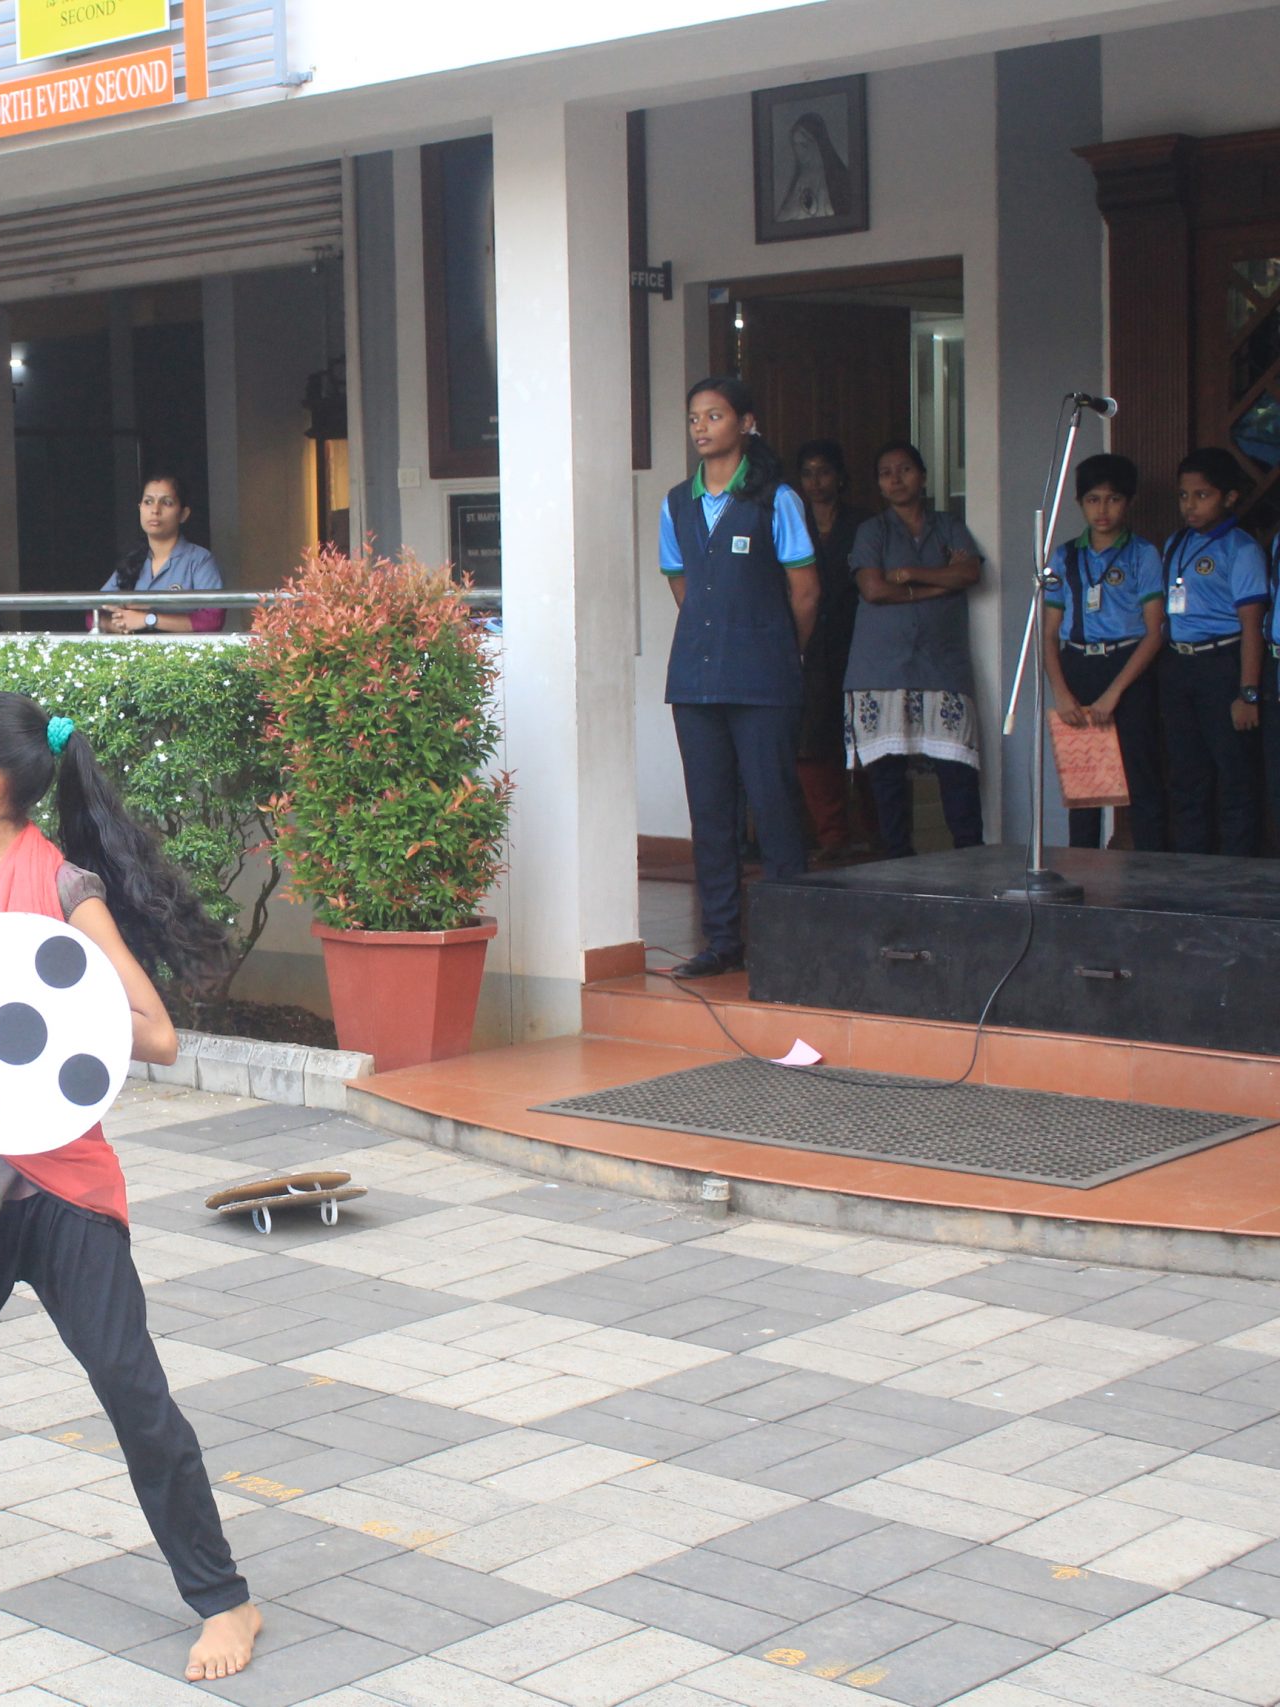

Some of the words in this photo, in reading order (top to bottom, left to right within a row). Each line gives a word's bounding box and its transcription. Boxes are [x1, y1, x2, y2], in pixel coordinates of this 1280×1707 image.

[60, 0, 116, 27] SECOND
[36, 75, 92, 118] EVERY
[95, 59, 168, 105] SECOND
[631, 271, 665, 288] FFICE
